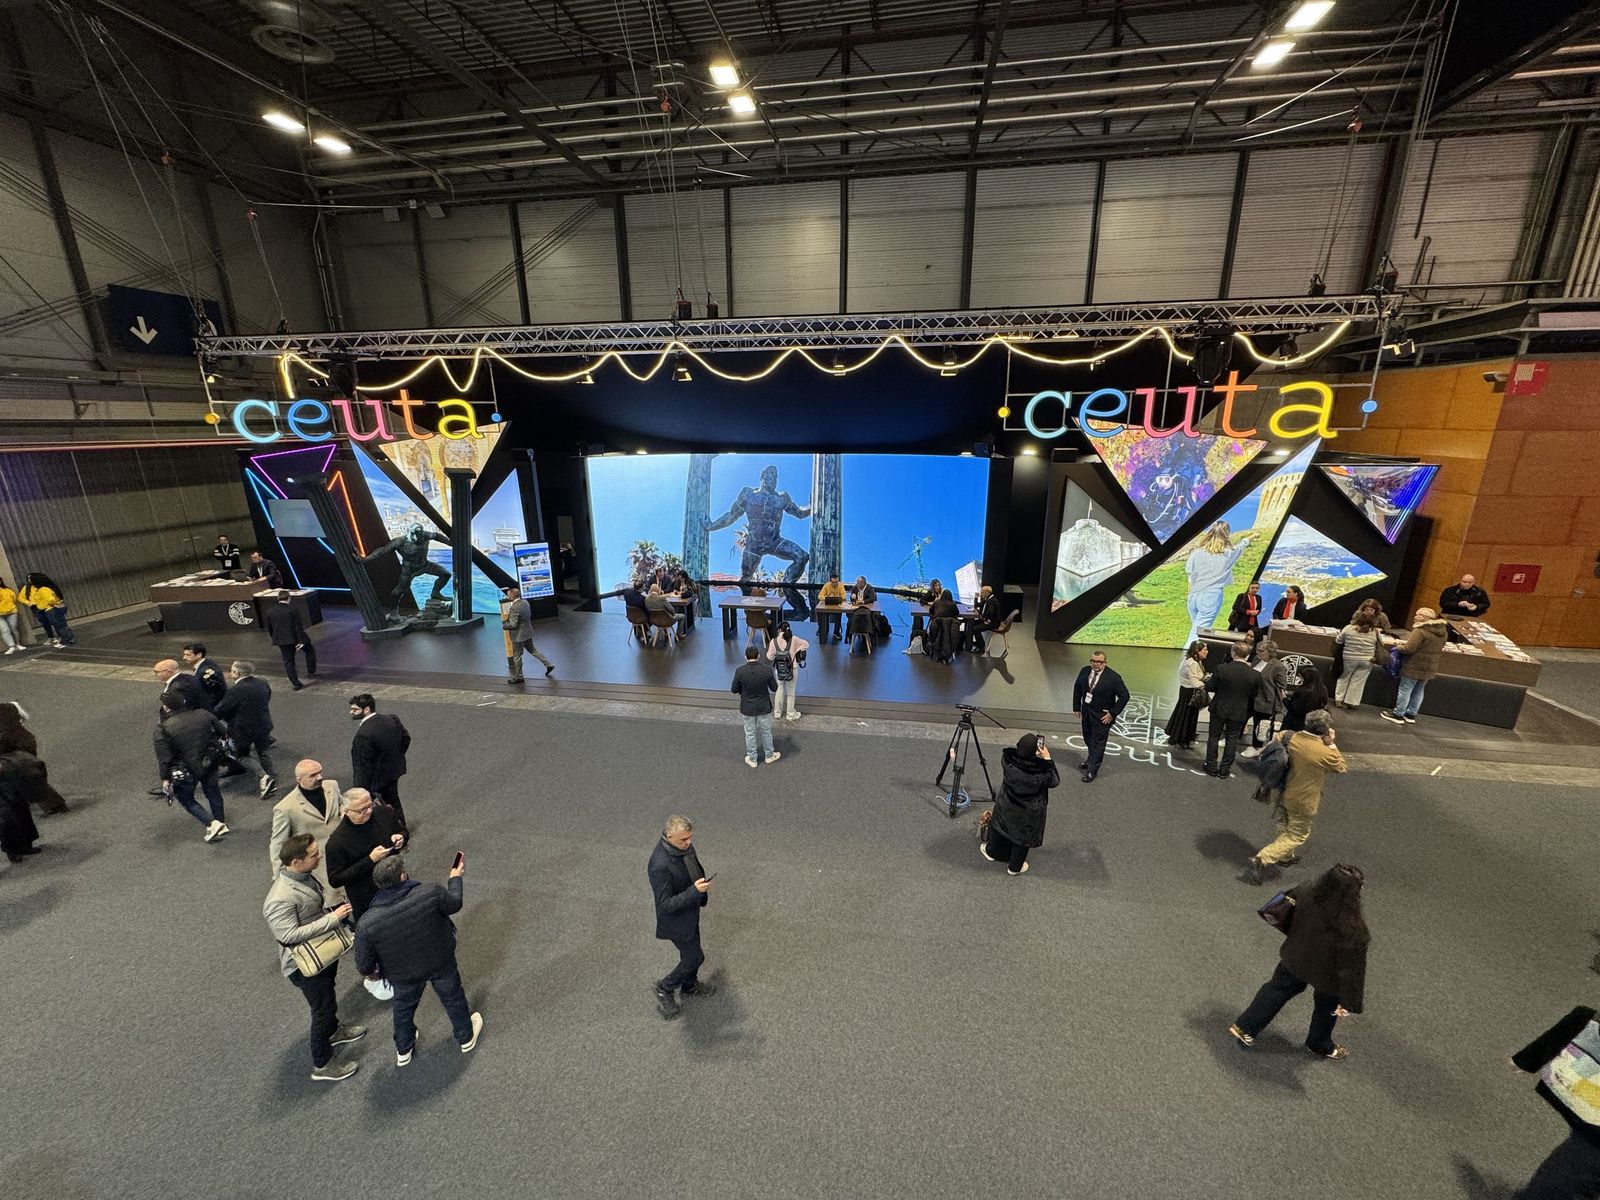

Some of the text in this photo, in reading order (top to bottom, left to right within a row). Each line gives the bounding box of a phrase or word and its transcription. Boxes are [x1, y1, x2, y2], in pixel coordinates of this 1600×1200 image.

[232, 388, 485, 443] ceuta
[1023, 370, 1339, 440] ceuta
[1065, 735, 1207, 776] ceut
